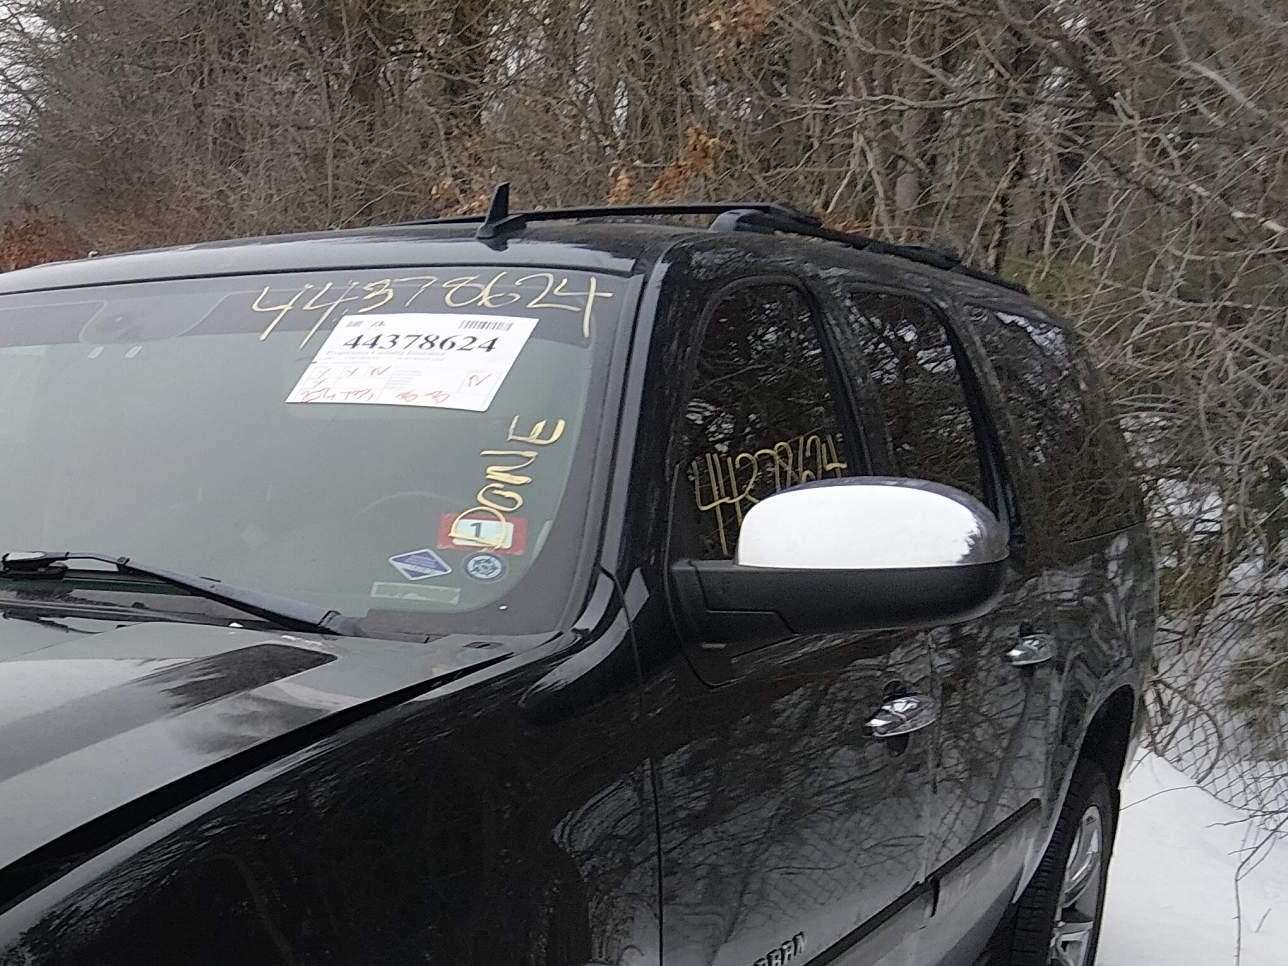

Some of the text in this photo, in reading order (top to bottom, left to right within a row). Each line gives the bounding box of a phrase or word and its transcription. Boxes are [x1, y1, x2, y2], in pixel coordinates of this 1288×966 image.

[251, 271, 613, 350] 44378624
[343, 333, 500, 352] 44378624
[470, 522, 483, 537] 1
